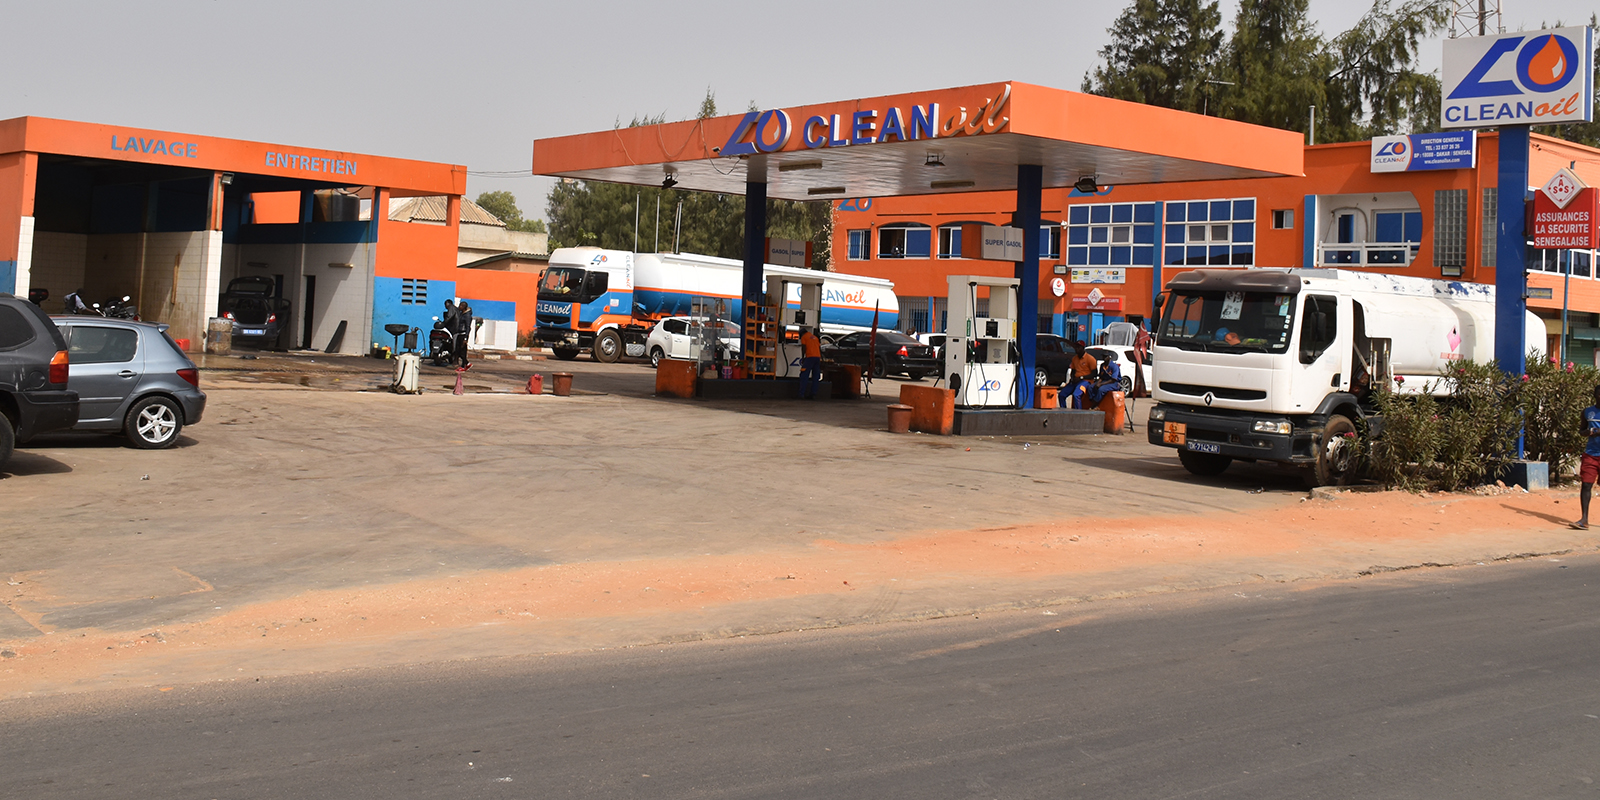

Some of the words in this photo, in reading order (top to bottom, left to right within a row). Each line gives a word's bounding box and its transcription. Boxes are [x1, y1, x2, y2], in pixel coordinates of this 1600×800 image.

[111, 135, 198, 159] LAVAGE
[265, 151, 357, 175] ENTRETIEN
[1535, 211, 1590, 222] ASSURANCES
[1535, 224, 1546, 234] LA
[1547, 223, 1589, 234] SECURITE
[985, 238, 1004, 246] SUPER
[1005, 240, 1022, 248] GASOIL
[1535, 236, 1589, 247] SENEGALAISE
[536, 303, 572, 315] CLEANoil
